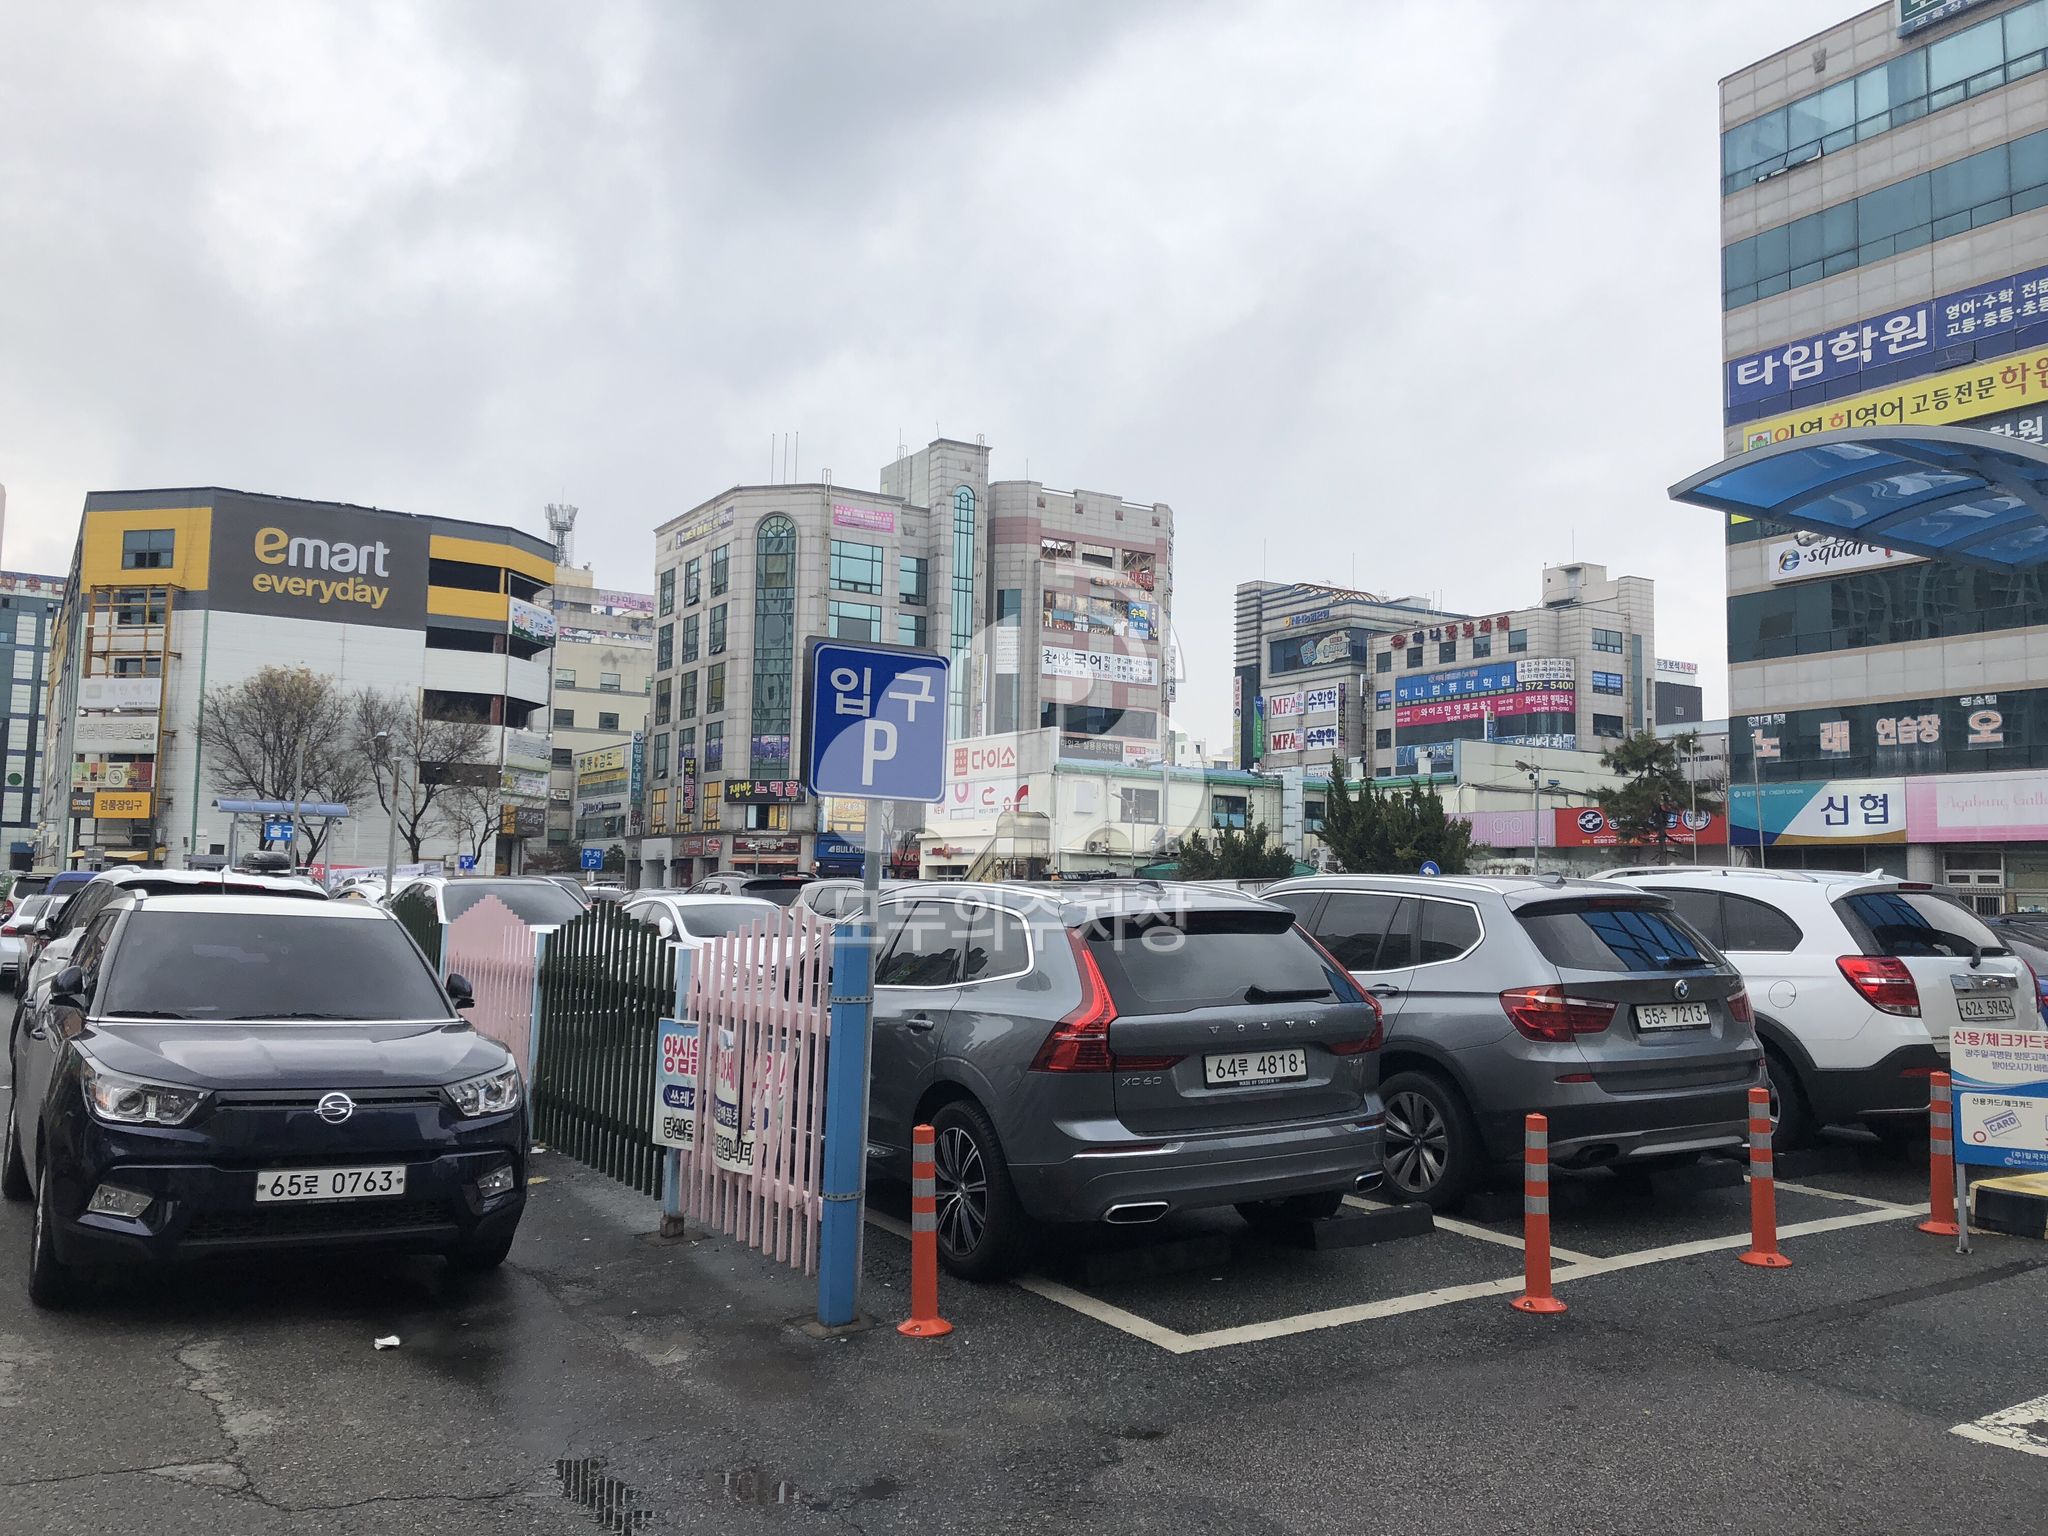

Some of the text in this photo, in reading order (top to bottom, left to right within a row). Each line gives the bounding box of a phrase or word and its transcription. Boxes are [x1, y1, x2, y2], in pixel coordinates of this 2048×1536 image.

[1945, 288, 2014, 320] 영어·수학
[1736, 308, 1928, 386] 타임학원
[254, 527, 390, 578] emart
[252, 573, 389, 609] everyday
[1074, 652, 1102, 670] 국어
[829, 667, 936, 722] 입구
[1525, 681, 1574, 691] 572-5400
[1271, 697, 1296, 716] MFA
[1524, 694, 1549, 706] 와이즈만
[1420, 705, 1451, 716] 와이즈만
[1876, 714, 1941, 746] 연습장
[1272, 733, 1296, 751] MFA
[861, 719, 898, 787] P
[971, 745, 1016, 771] 다이소
[729, 780, 798, 798] 쟁반 노래홀
[99, 799, 143, 811] 검품장입구
[1819, 793, 1889, 826] 신협
[588, 859, 597, 867] P
[1643, 1005, 1704, 1025] 55수 7213
[1965, 1000, 2010, 1016] 62소 5943
[1208, 1019, 1317, 1034] VOLVO
[1215, 1053, 1299, 1079] 64루 4818
[1992, 1061, 2032, 1072] 받아오시기
[1971, 1097, 2033, 1109] 신용카드/체크카드
[1989, 1116, 2017, 1132] CARD
[269, 1170, 394, 1198] 65로 0763
